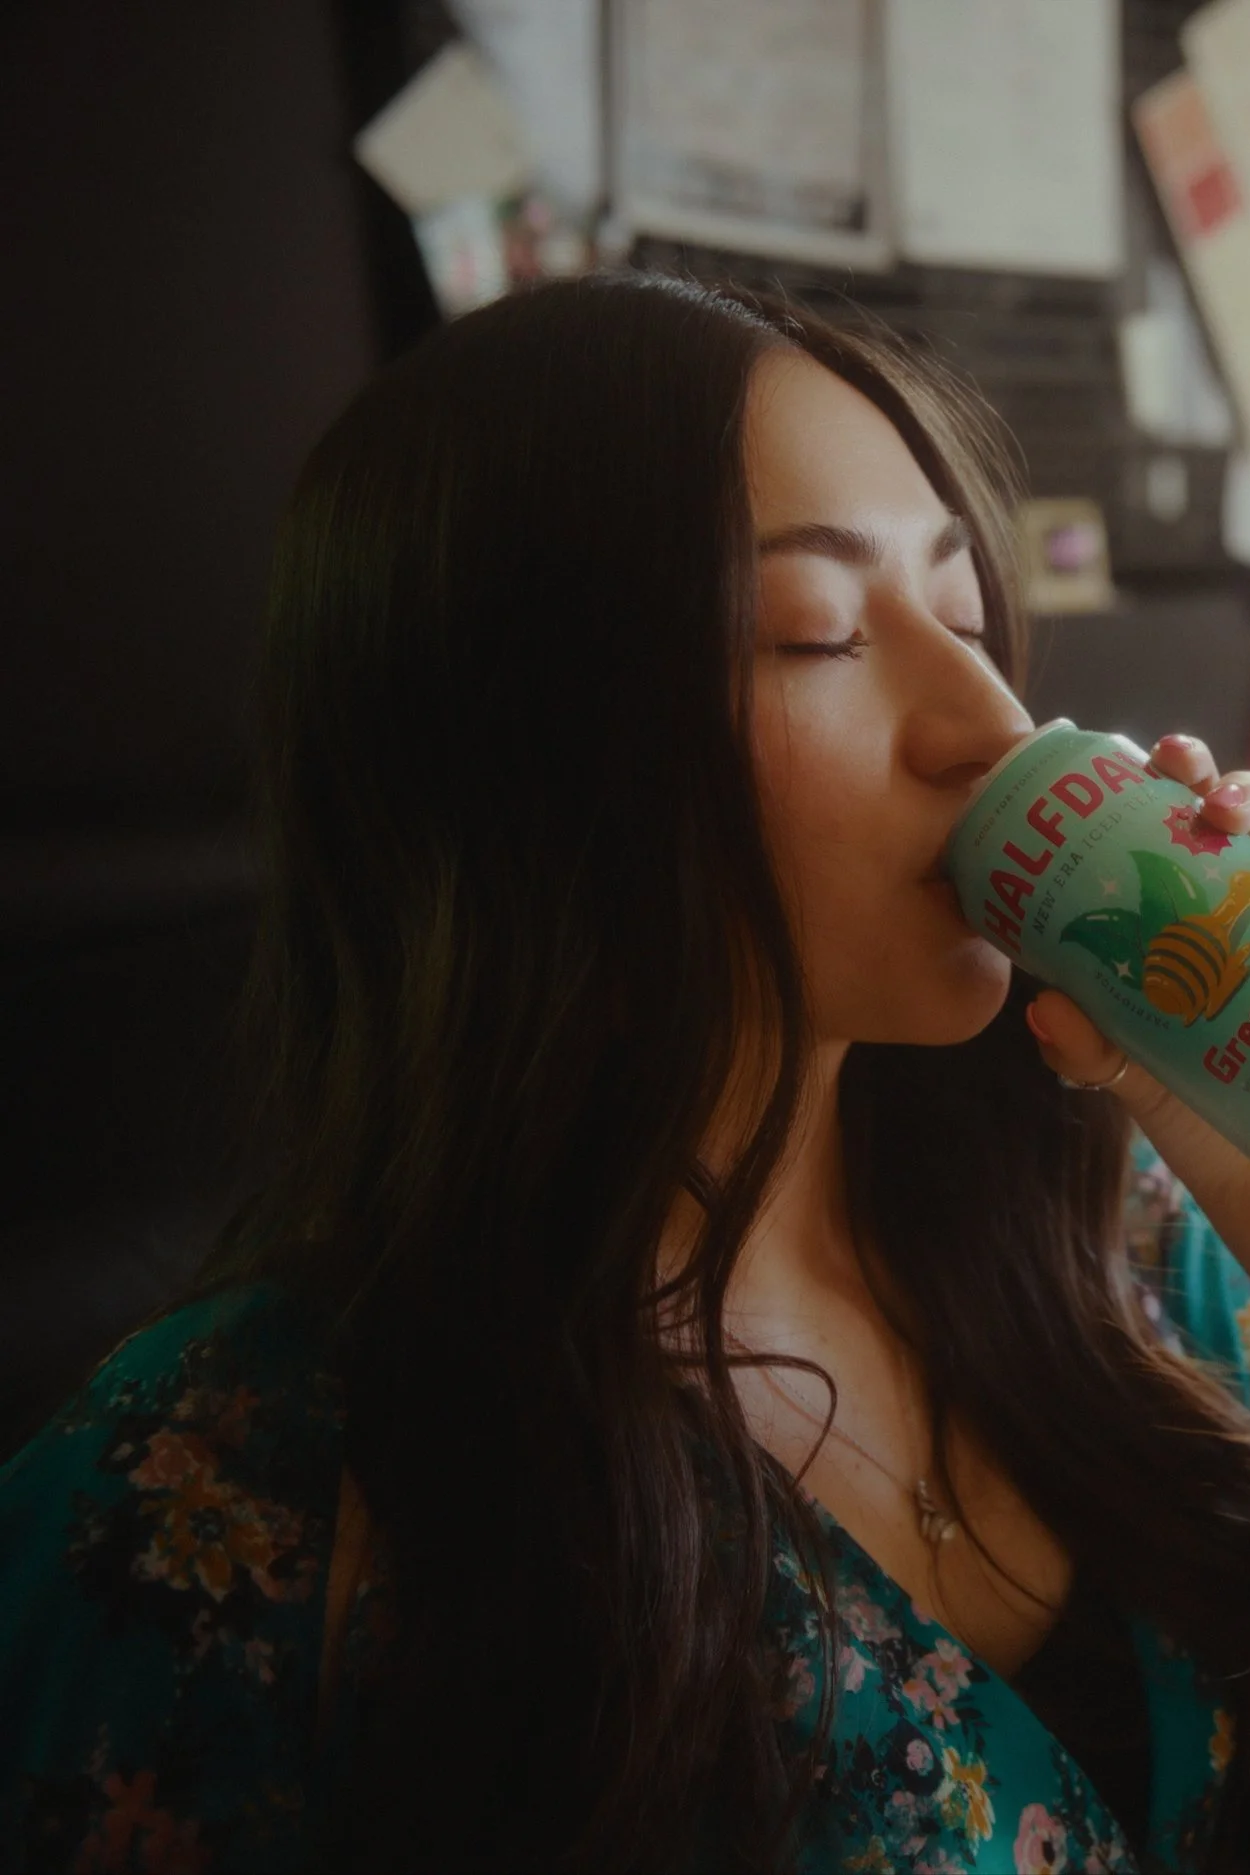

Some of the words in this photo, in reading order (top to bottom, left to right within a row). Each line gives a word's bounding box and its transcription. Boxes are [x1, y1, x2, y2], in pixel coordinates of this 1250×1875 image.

[995, 793, 1014, 815] FOR
[1032, 891, 1056, 935] NEW
[1054, 852, 1084, 888] ERA
[1082, 811, 1123, 849] ICED
